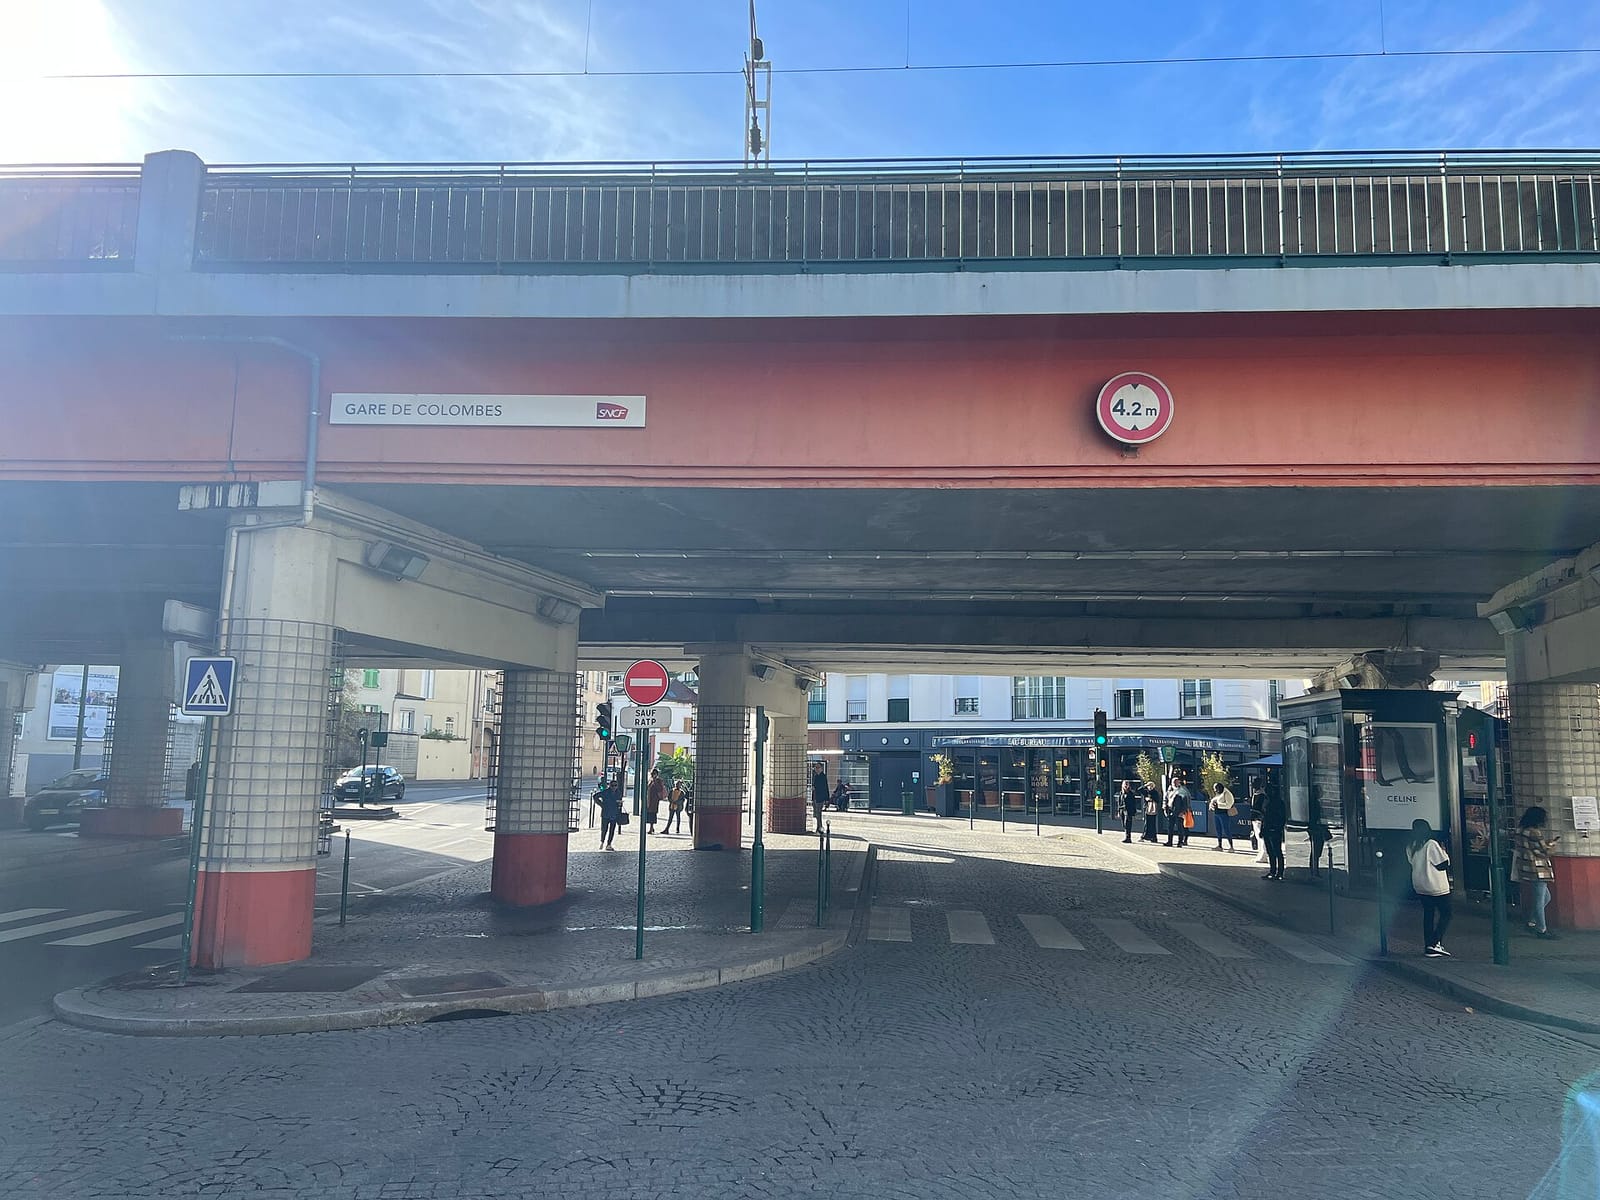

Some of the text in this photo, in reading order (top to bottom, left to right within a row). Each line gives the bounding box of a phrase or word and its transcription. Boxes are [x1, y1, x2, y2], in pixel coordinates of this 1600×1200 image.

[345, 403, 502, 417] GARE DE COLOMBES
[1112, 398, 1157, 416] 4.2 m
[598, 409, 626, 418] SNCF
[635, 709, 657, 717] SAUF
[634, 718, 657, 726] RATP
[1387, 795, 1417, 803] CELINE
